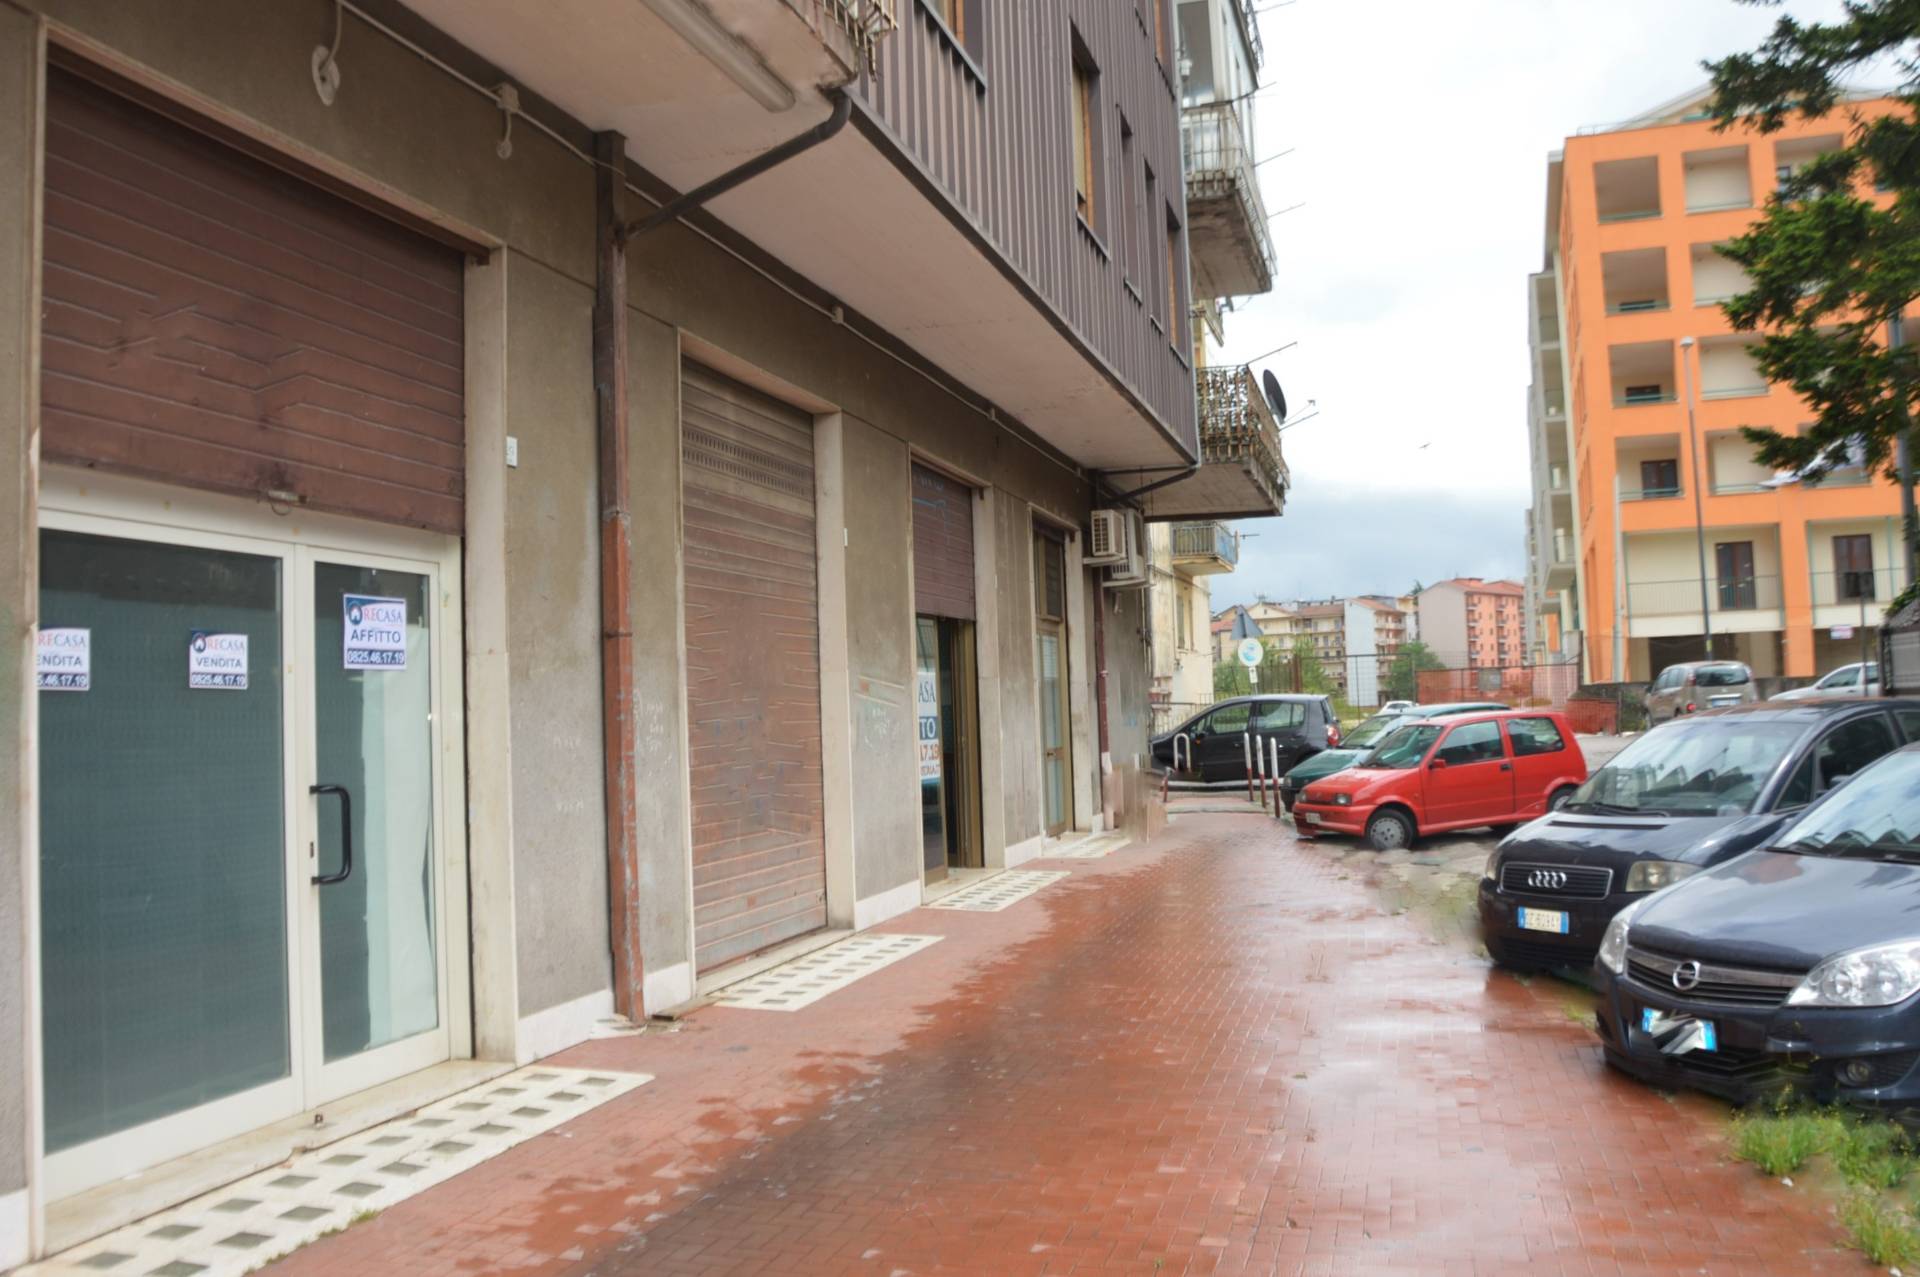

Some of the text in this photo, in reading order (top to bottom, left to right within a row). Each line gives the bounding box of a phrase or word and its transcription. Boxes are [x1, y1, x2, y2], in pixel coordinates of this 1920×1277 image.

[364, 607, 403, 623] RECASA
[208, 638, 245, 650] RECASA
[350, 629, 402, 644] AFFITTO
[195, 657, 243, 668] VENDITA
[920, 718, 936, 739] TO
